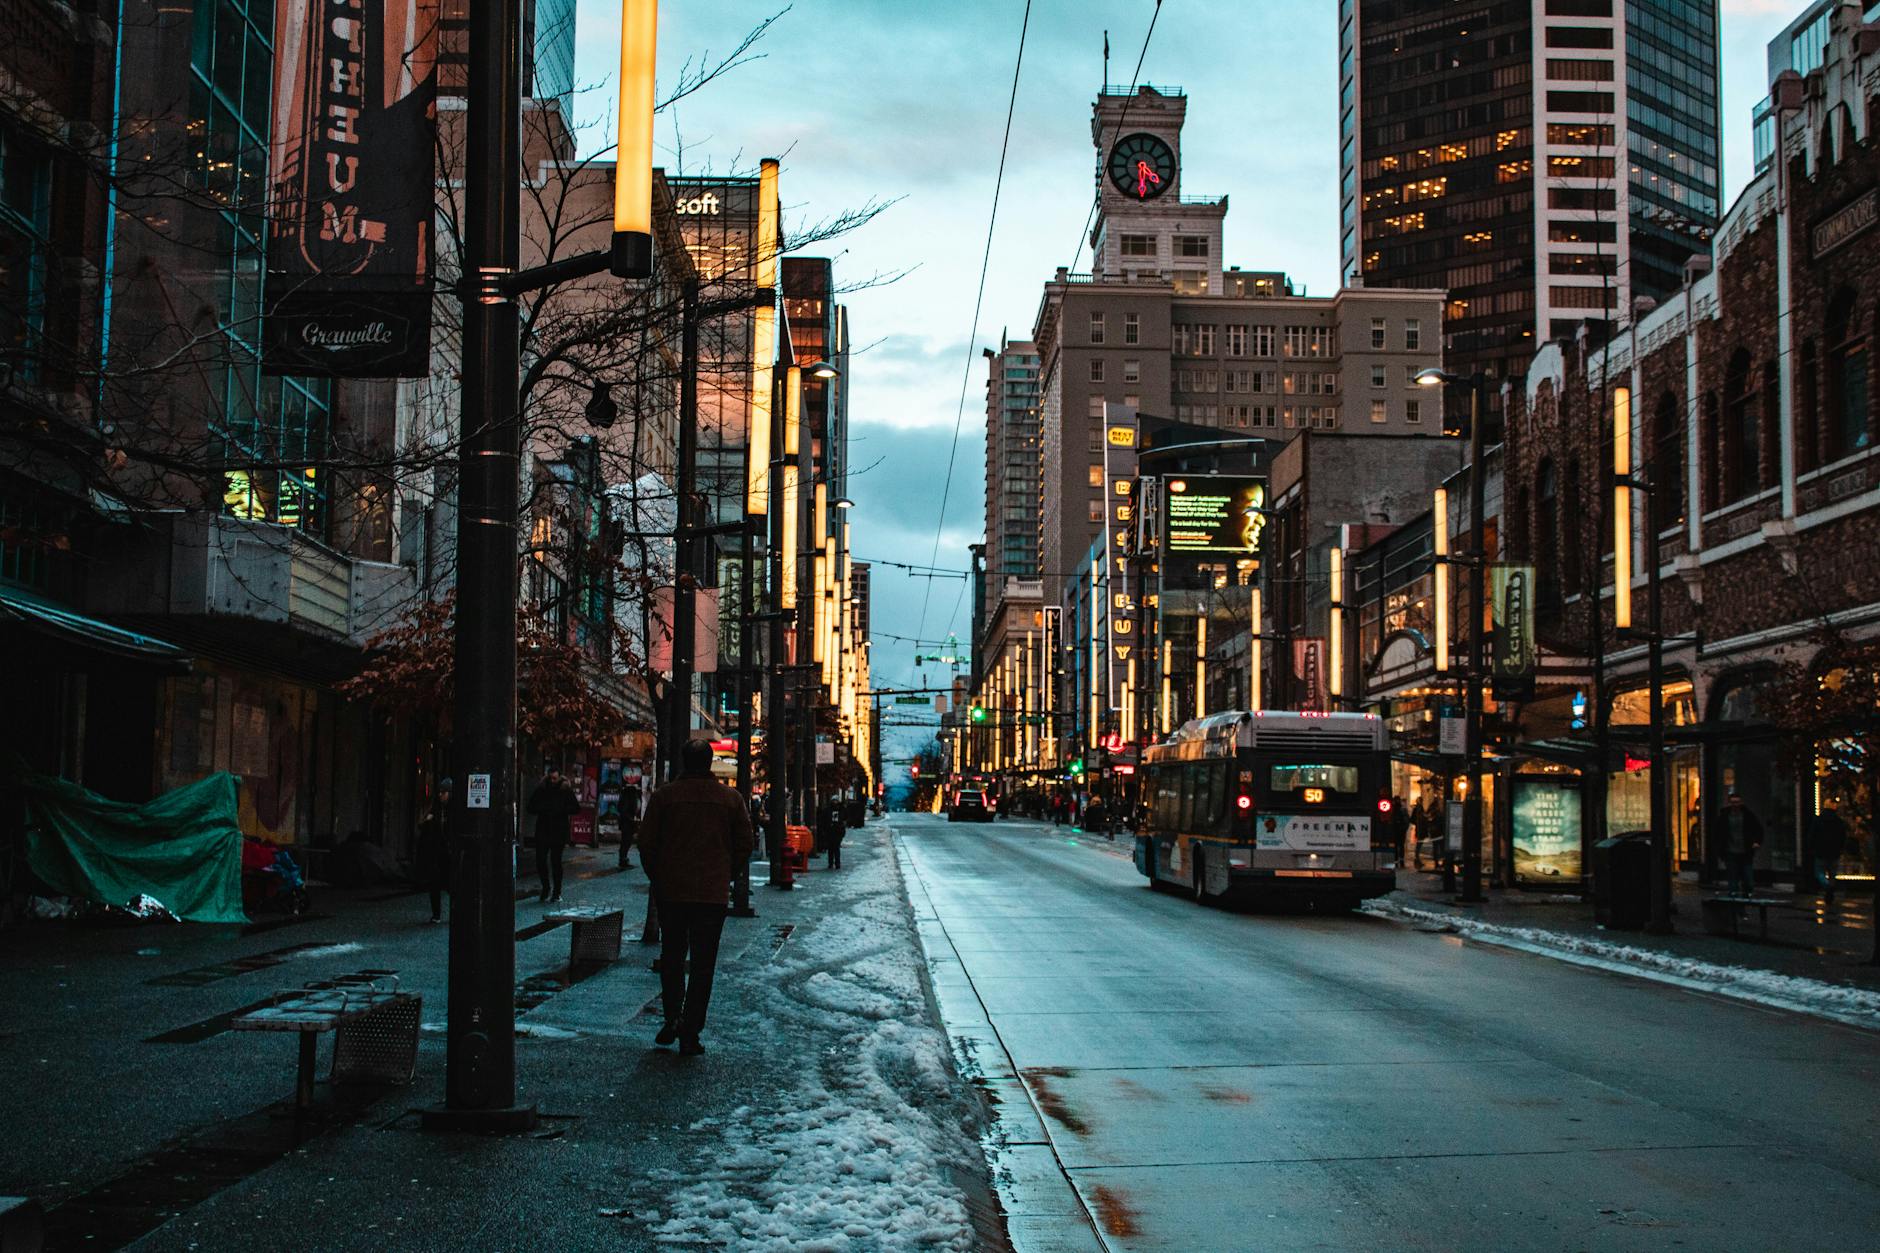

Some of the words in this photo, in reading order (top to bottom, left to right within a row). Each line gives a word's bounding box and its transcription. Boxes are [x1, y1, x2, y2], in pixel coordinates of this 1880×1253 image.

[301, 321, 393, 349] Granville
[1509, 576, 1521, 667] ORPHEUM
[1304, 788, 1324, 803] 50
[1535, 801, 1560, 809] ONLY
[1292, 823, 1369, 832] FREEMAN
[1532, 818, 1562, 826] THOSE
